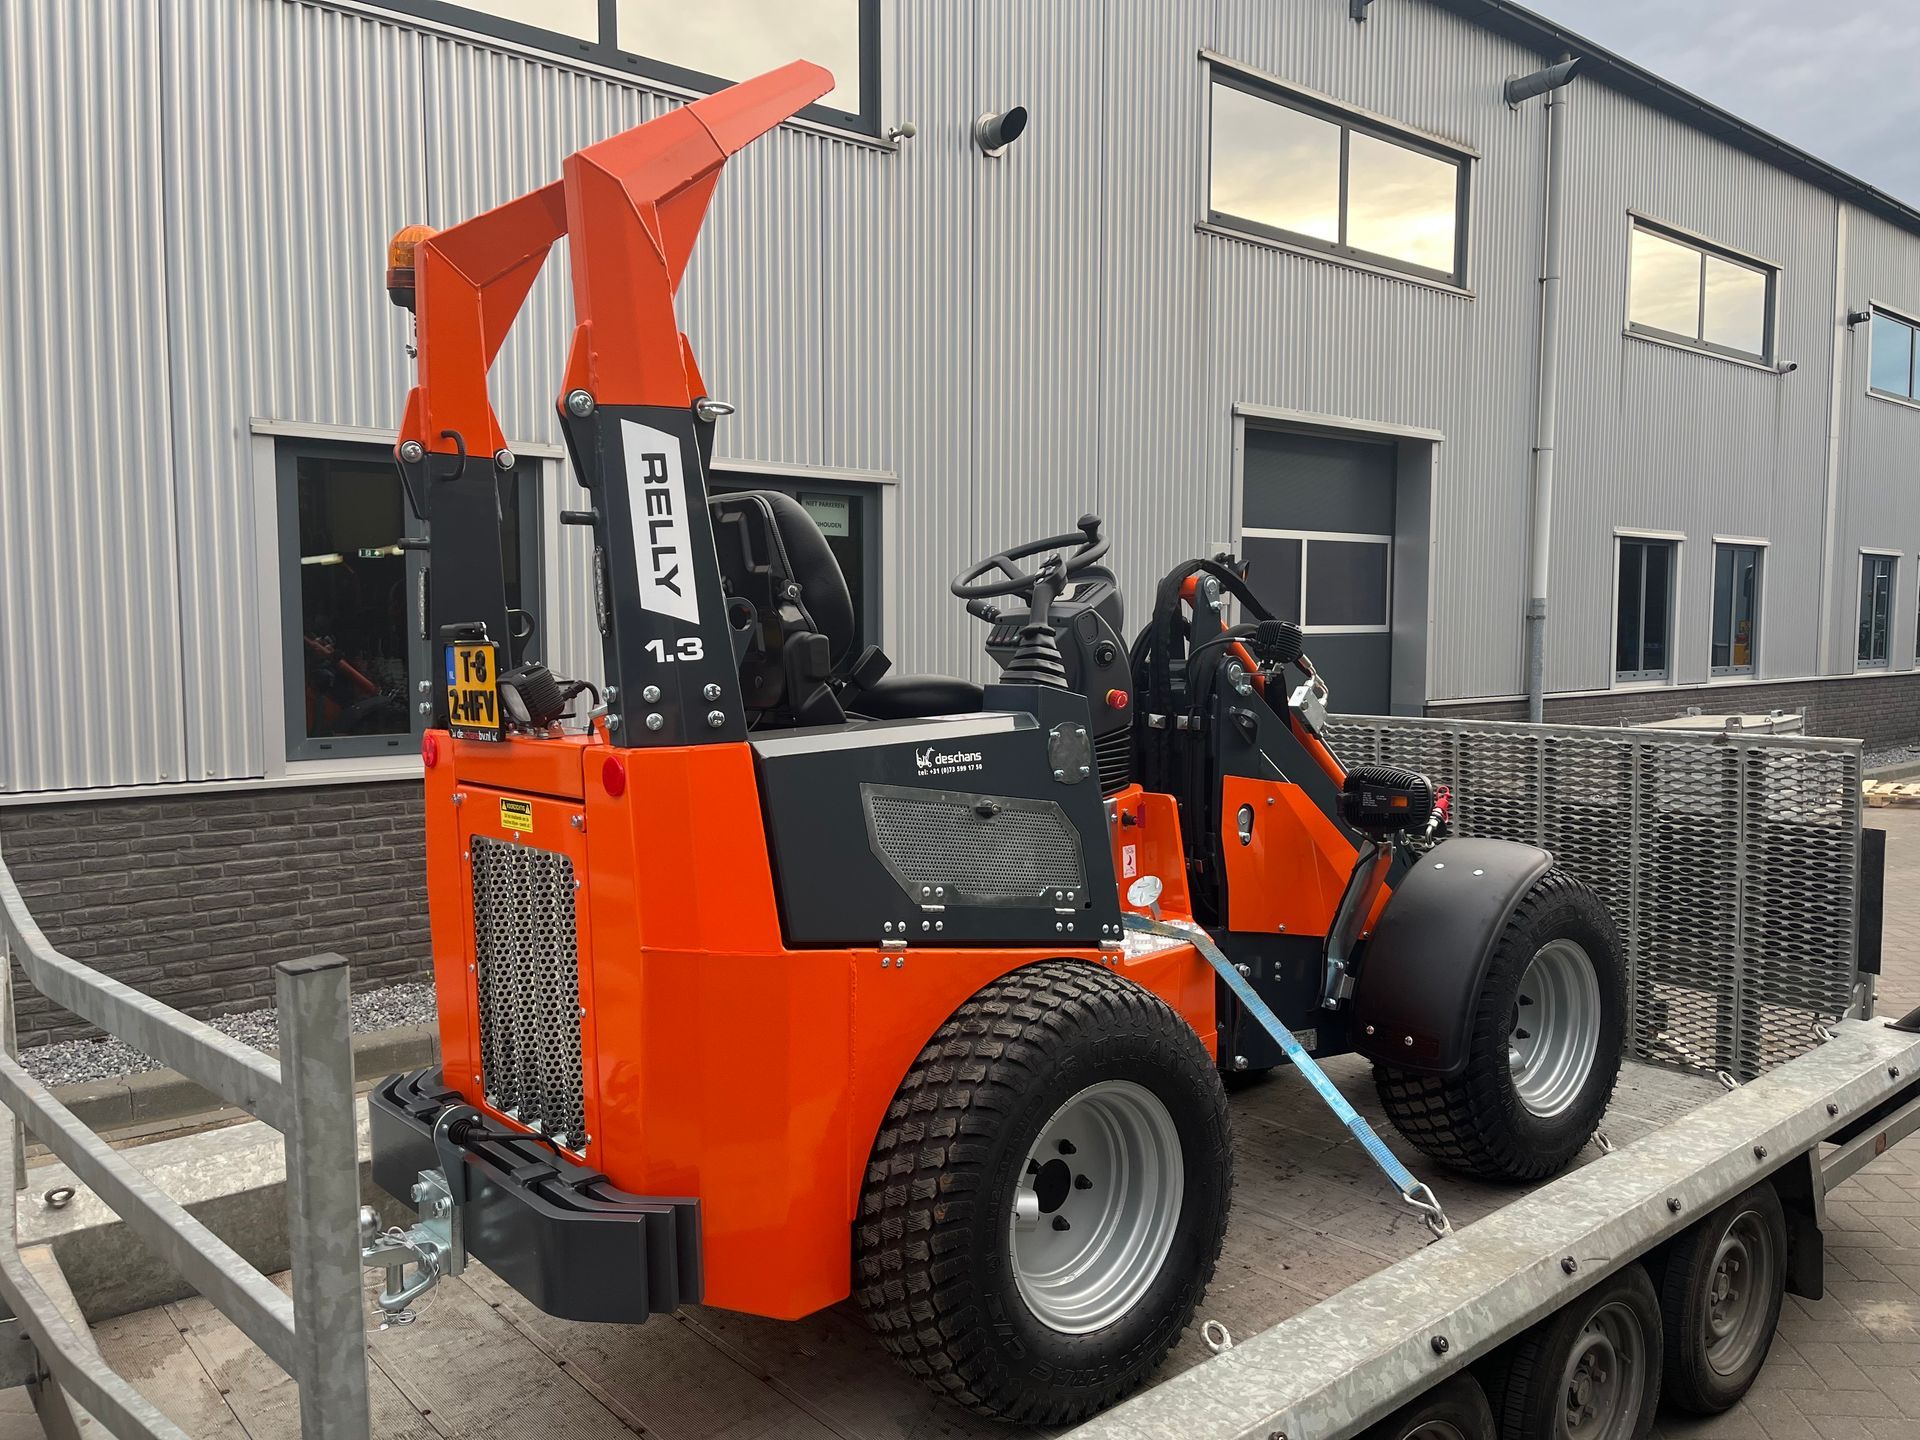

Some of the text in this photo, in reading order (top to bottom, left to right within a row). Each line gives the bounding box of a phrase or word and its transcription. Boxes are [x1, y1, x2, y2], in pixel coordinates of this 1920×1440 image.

[819, 501, 845, 509] PARKEREN
[641, 452, 682, 598] RELLY
[644, 637, 704, 663] 1.3
[460, 650, 487, 683] T-8
[449, 689, 494, 723] 2-HFV
[930, 767, 940, 775] +31
[935, 751, 982, 765] deschans
